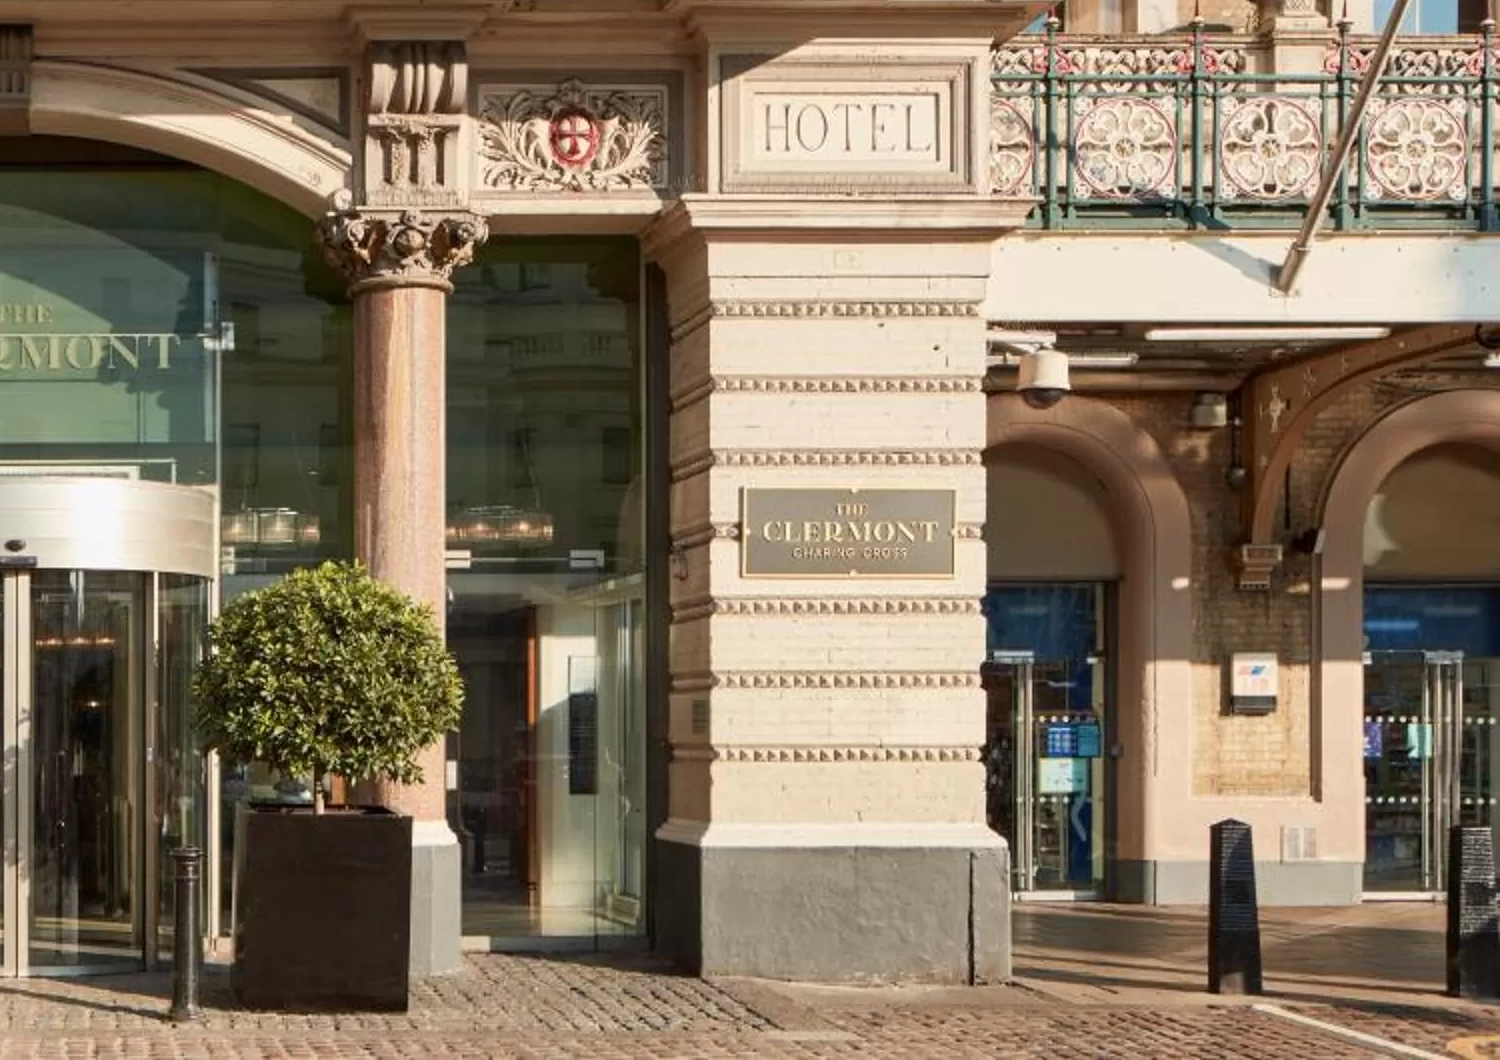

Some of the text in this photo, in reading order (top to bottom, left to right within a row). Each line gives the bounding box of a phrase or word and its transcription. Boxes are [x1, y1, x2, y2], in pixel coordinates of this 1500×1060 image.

[764, 102, 932, 153] HOTEL
[835, 503, 868, 517] THE
[762, 520, 940, 543] CLERMONT
[791, 546, 908, 559] CHARING CROSS
